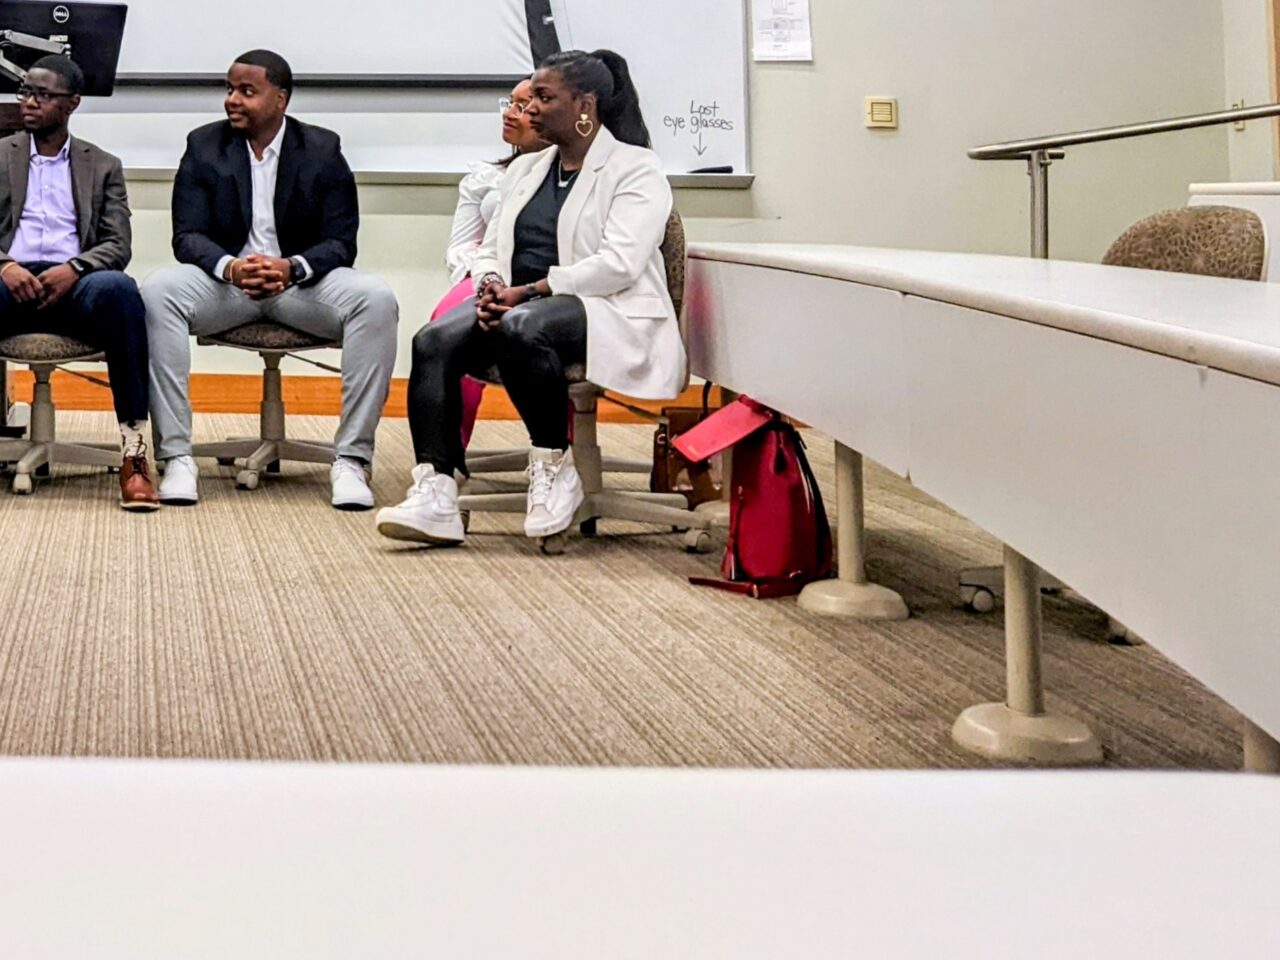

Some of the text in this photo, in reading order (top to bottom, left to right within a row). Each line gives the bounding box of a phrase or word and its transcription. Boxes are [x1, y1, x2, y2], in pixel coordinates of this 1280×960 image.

[690, 99, 721, 118] Lost
[663, 112, 734, 136] eye glasses
